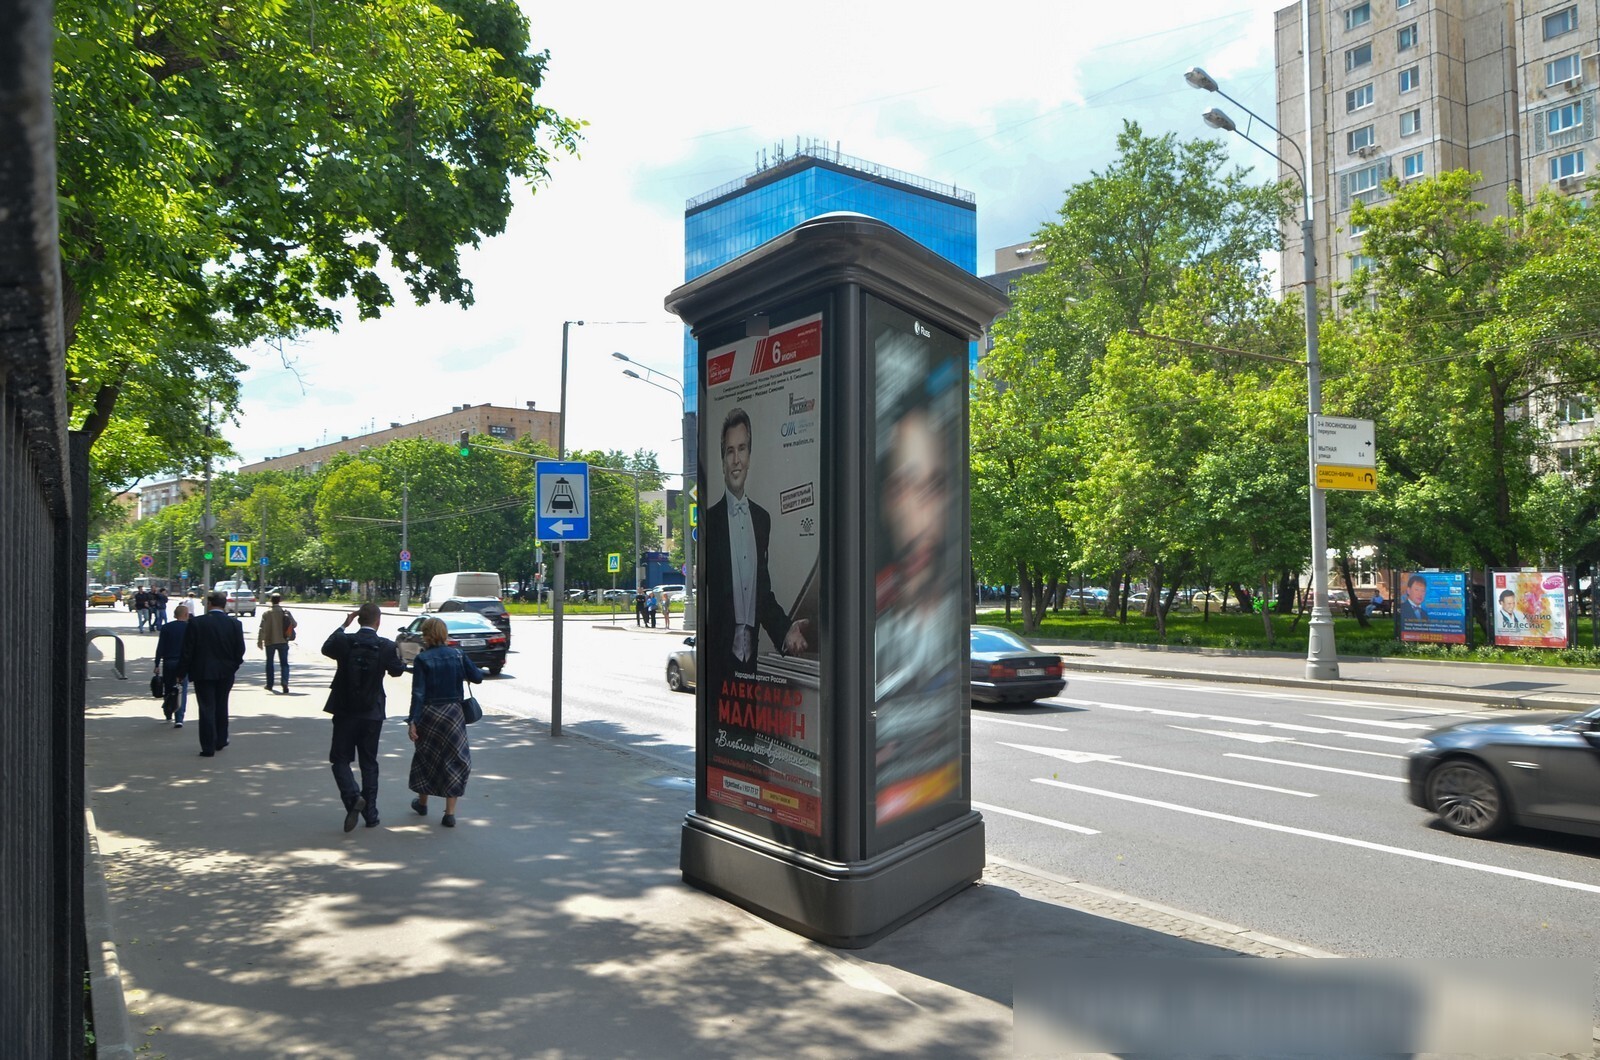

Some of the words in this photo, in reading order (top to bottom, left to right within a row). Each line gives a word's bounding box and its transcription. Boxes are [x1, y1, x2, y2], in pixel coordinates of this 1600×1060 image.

[772, 341, 781, 364] 6
[1502, 621, 1545, 630] Иглесиас
[1523, 613, 1552, 622] Хулио
[735, 671, 755, 680] Народный
[755, 674, 770, 683] артист
[770, 675, 787, 684] России
[721, 680, 803, 707] АЛЕКСАНДР
[718, 699, 805, 740] МАЛИНИН
